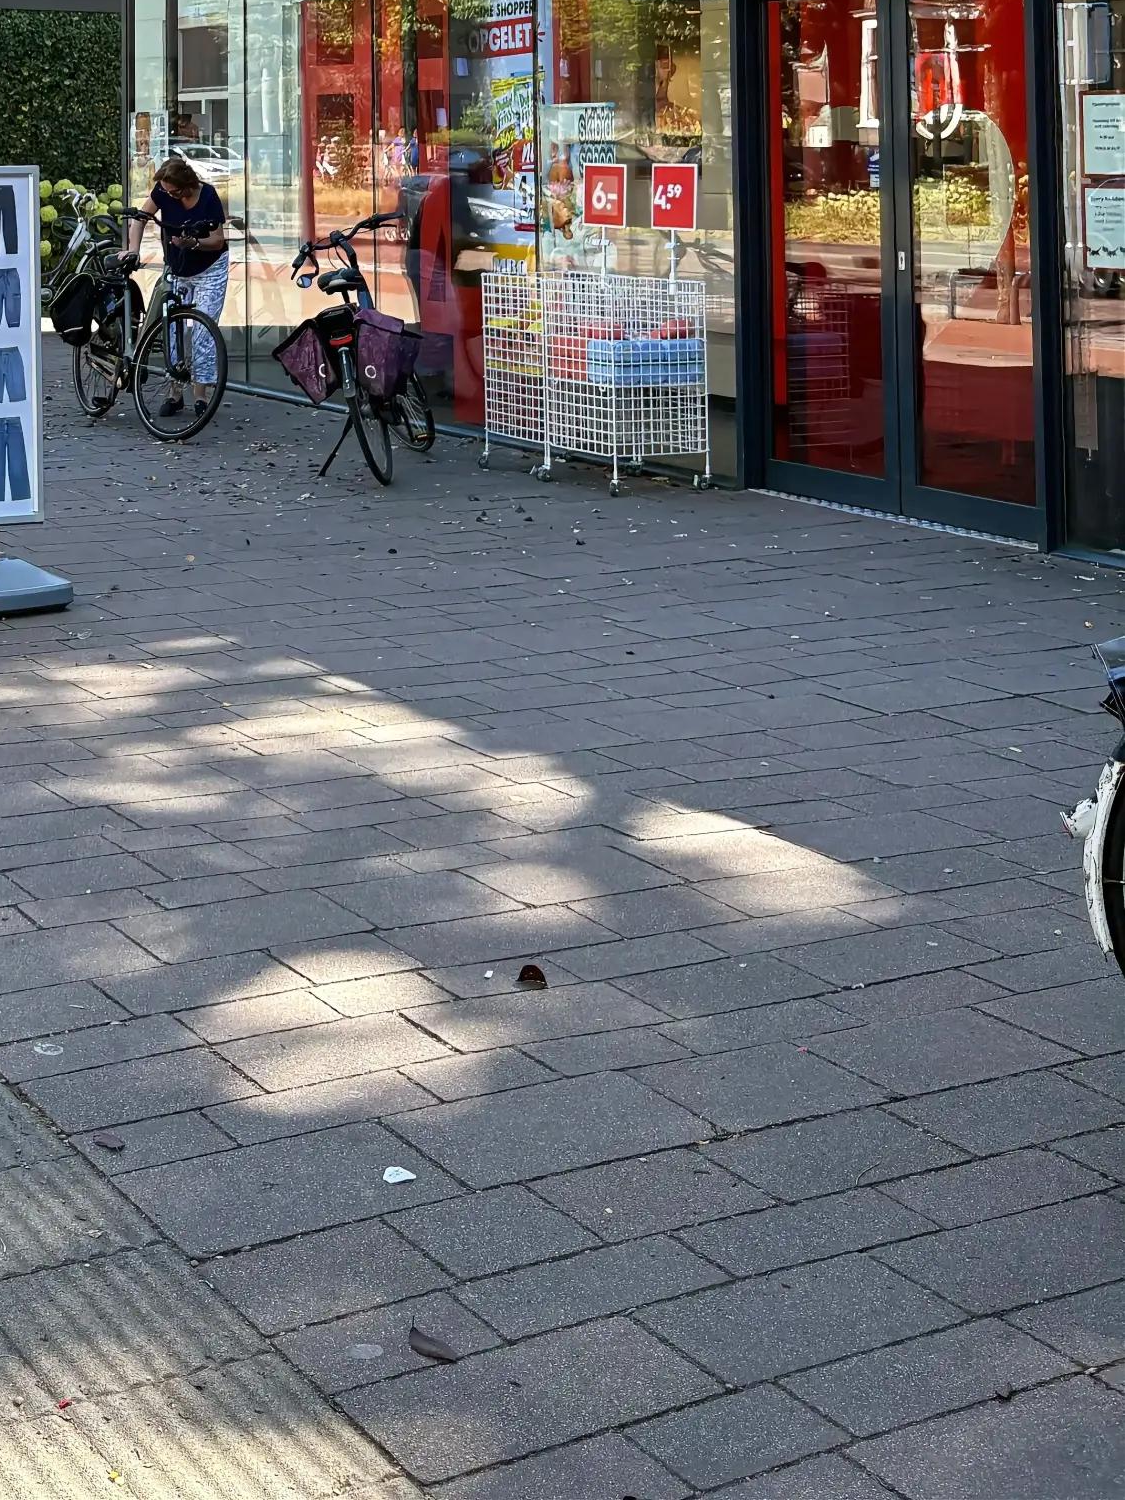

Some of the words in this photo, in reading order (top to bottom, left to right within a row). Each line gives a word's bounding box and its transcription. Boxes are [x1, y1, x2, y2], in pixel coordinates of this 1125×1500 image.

[496, 0, 533, 17] SHOPPER
[469, 22, 532, 53] OPGELET
[579, 107, 616, 142] skibidi
